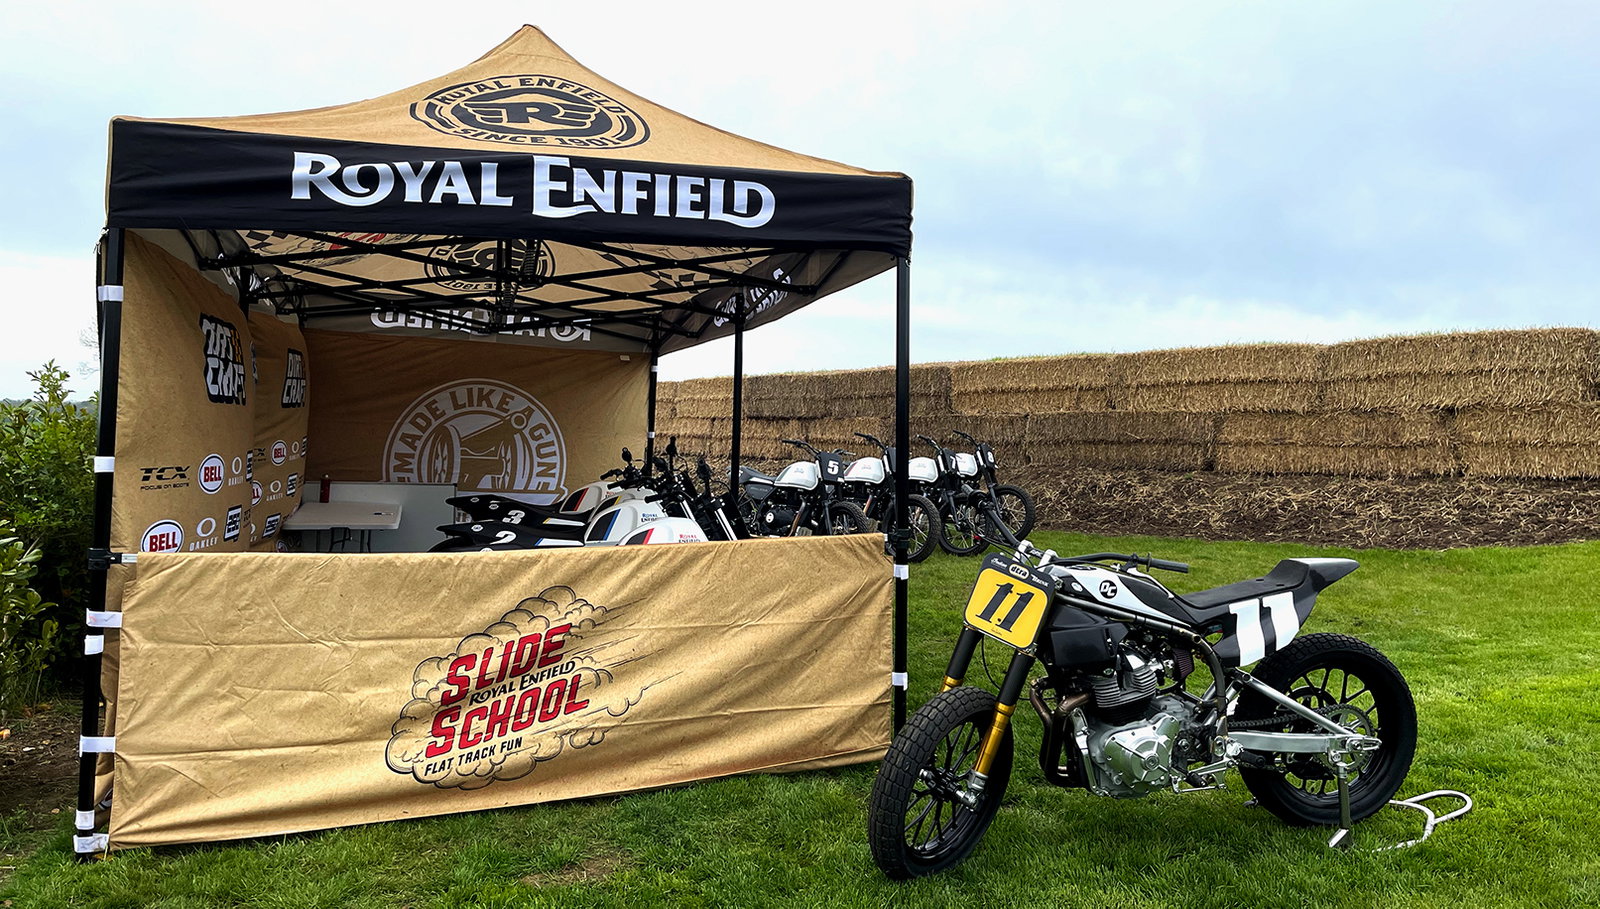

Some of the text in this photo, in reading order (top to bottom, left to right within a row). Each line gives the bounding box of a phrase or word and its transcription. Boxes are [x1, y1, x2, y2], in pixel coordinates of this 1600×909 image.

[433, 77, 627, 114] ROYAL ENFIELD
[453, 127, 621, 148] SINCE 1901
[290, 151, 776, 228] ROYAL ENFIELD
[393, 399, 446, 474] MADE
[449, 387, 516, 413] LIKE
[528, 422, 557, 478] GUN
[140, 466, 191, 481] TCX
[203, 466, 222, 483] BELL
[827, 460, 839, 475] 5
[502, 510, 526, 525] 3
[149, 531, 178, 552] BELL
[189, 536, 219, 552] OAKLEY
[489, 530, 517, 545] 2
[1010, 565, 1028, 578] dtra
[1100, 583, 1117, 597] DC
[975, 582, 1035, 633] 11
[1228, 591, 1300, 668] 11
[440, 622, 573, 707] SLIDE
[468, 660, 576, 706] ROYAL ENFIELD
[425, 673, 590, 759] SCHOOL
[424, 736, 523, 776] FLAT TRACK FUN
